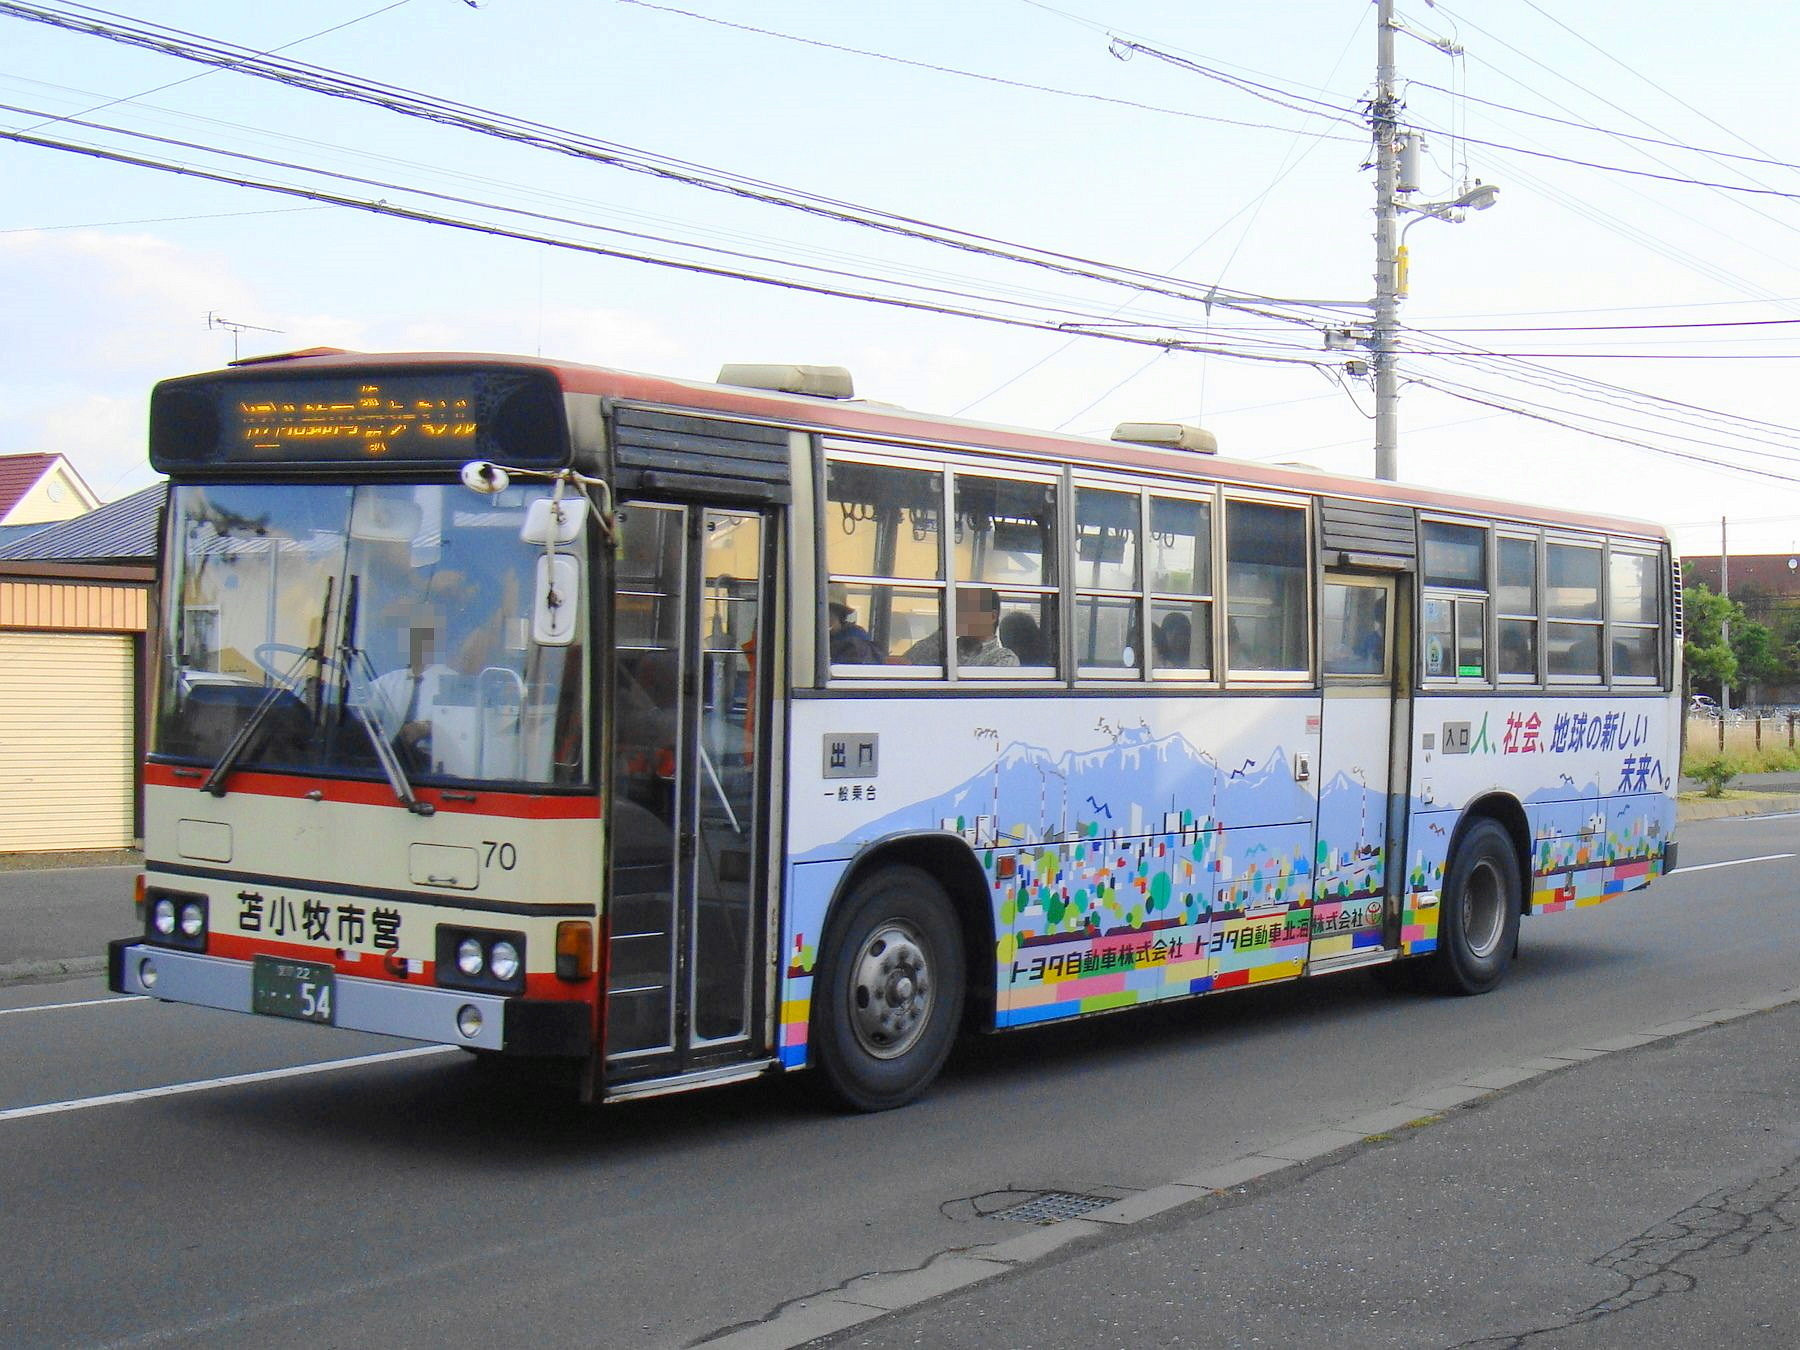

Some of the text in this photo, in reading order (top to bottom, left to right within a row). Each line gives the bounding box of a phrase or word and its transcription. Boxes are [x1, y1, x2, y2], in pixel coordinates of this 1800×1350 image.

[1445, 728, 1469, 747] 入口
[823, 785, 877, 802] 一般乗合
[482, 840, 516, 871] 70
[237, 890, 402, 950] 苫小牧市営
[296, 966, 311, 980] 22
[1010, 934, 1184, 983] トヨタ自動車株式会社
[301, 982, 331, 1019] 54
